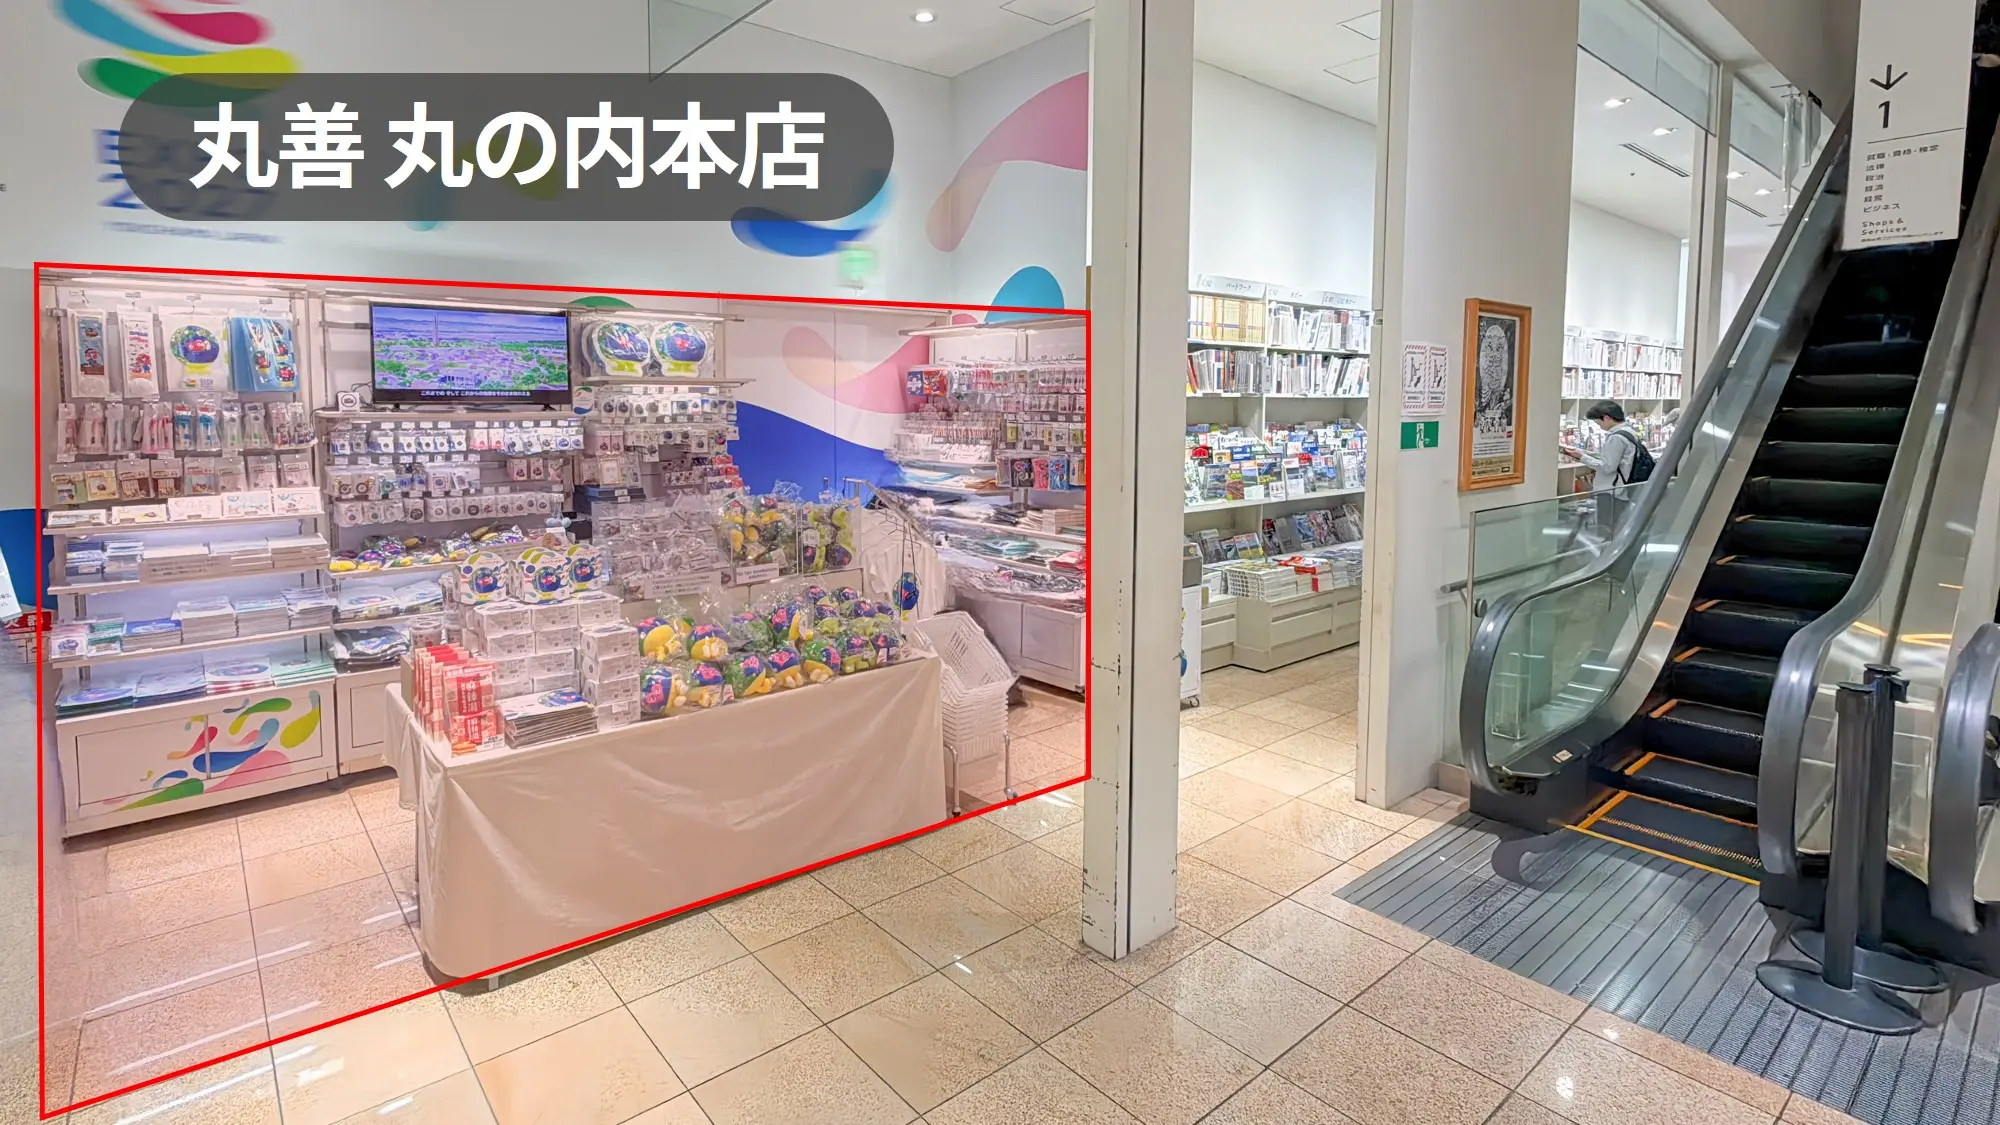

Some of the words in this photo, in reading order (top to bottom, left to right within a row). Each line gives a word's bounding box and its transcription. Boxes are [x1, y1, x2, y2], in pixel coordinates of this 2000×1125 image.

[1878, 100, 1890, 128] 1
[1863, 203, 1900, 213] ビジネス
[1861, 227, 1907, 235] Services
